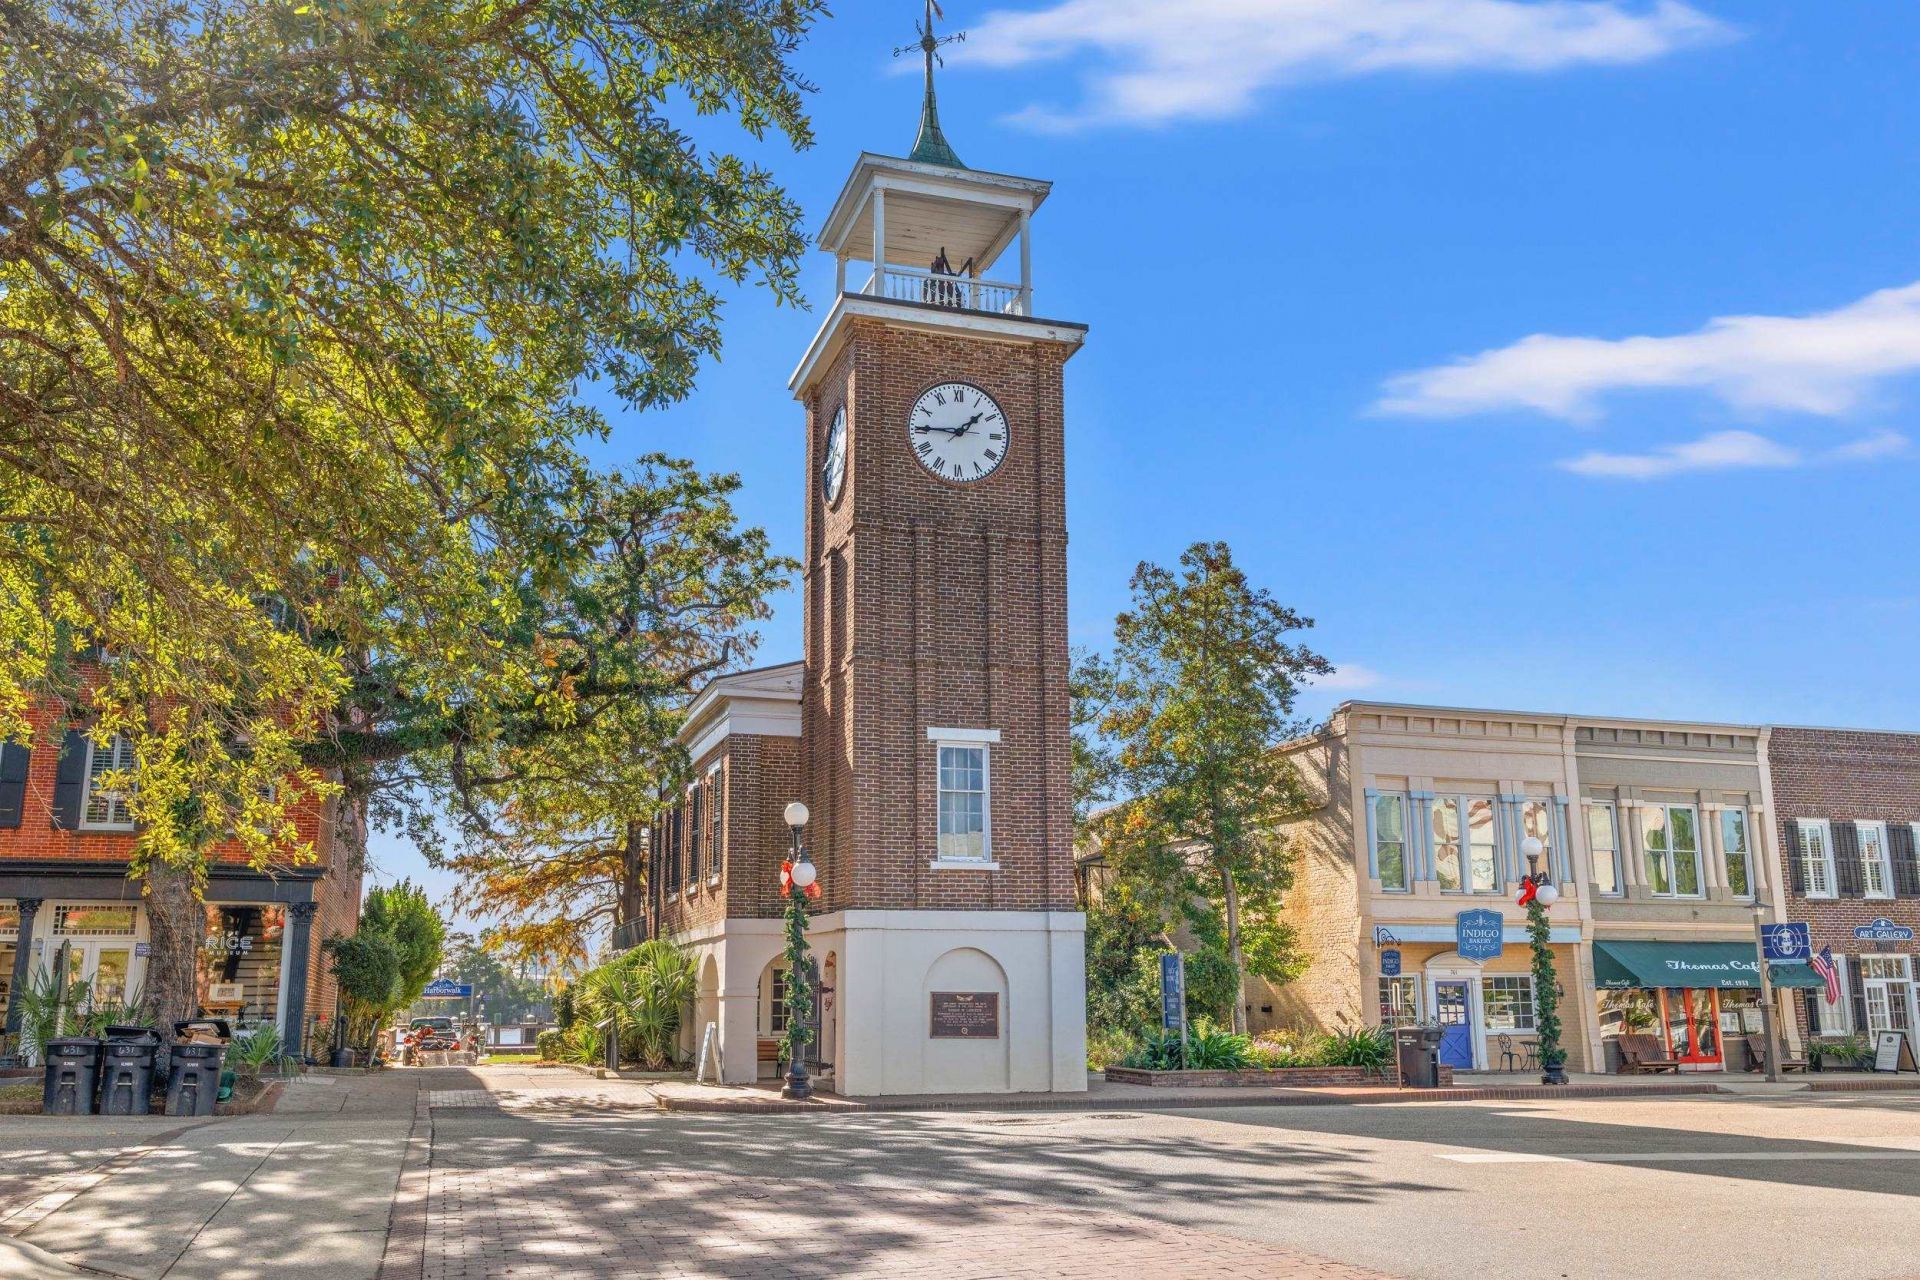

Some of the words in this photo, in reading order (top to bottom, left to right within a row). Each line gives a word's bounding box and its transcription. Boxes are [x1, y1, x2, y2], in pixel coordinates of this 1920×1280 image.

[934, 392, 946, 406] XI
[954, 390, 964, 402] XII
[920, 406, 932, 418] X
[972, 460, 982, 474] V
[1462, 930, 1499, 938] INDIGO
[1860, 930, 1873, 938] ART
[1876, 930, 1909, 938] GALLERY
[205, 936, 254, 950] RICE
[1666, 960, 1729, 970] Thomas
[1602, 1000, 1634, 1008] Thomas
[1722, 998, 1754, 1008] Thomas
